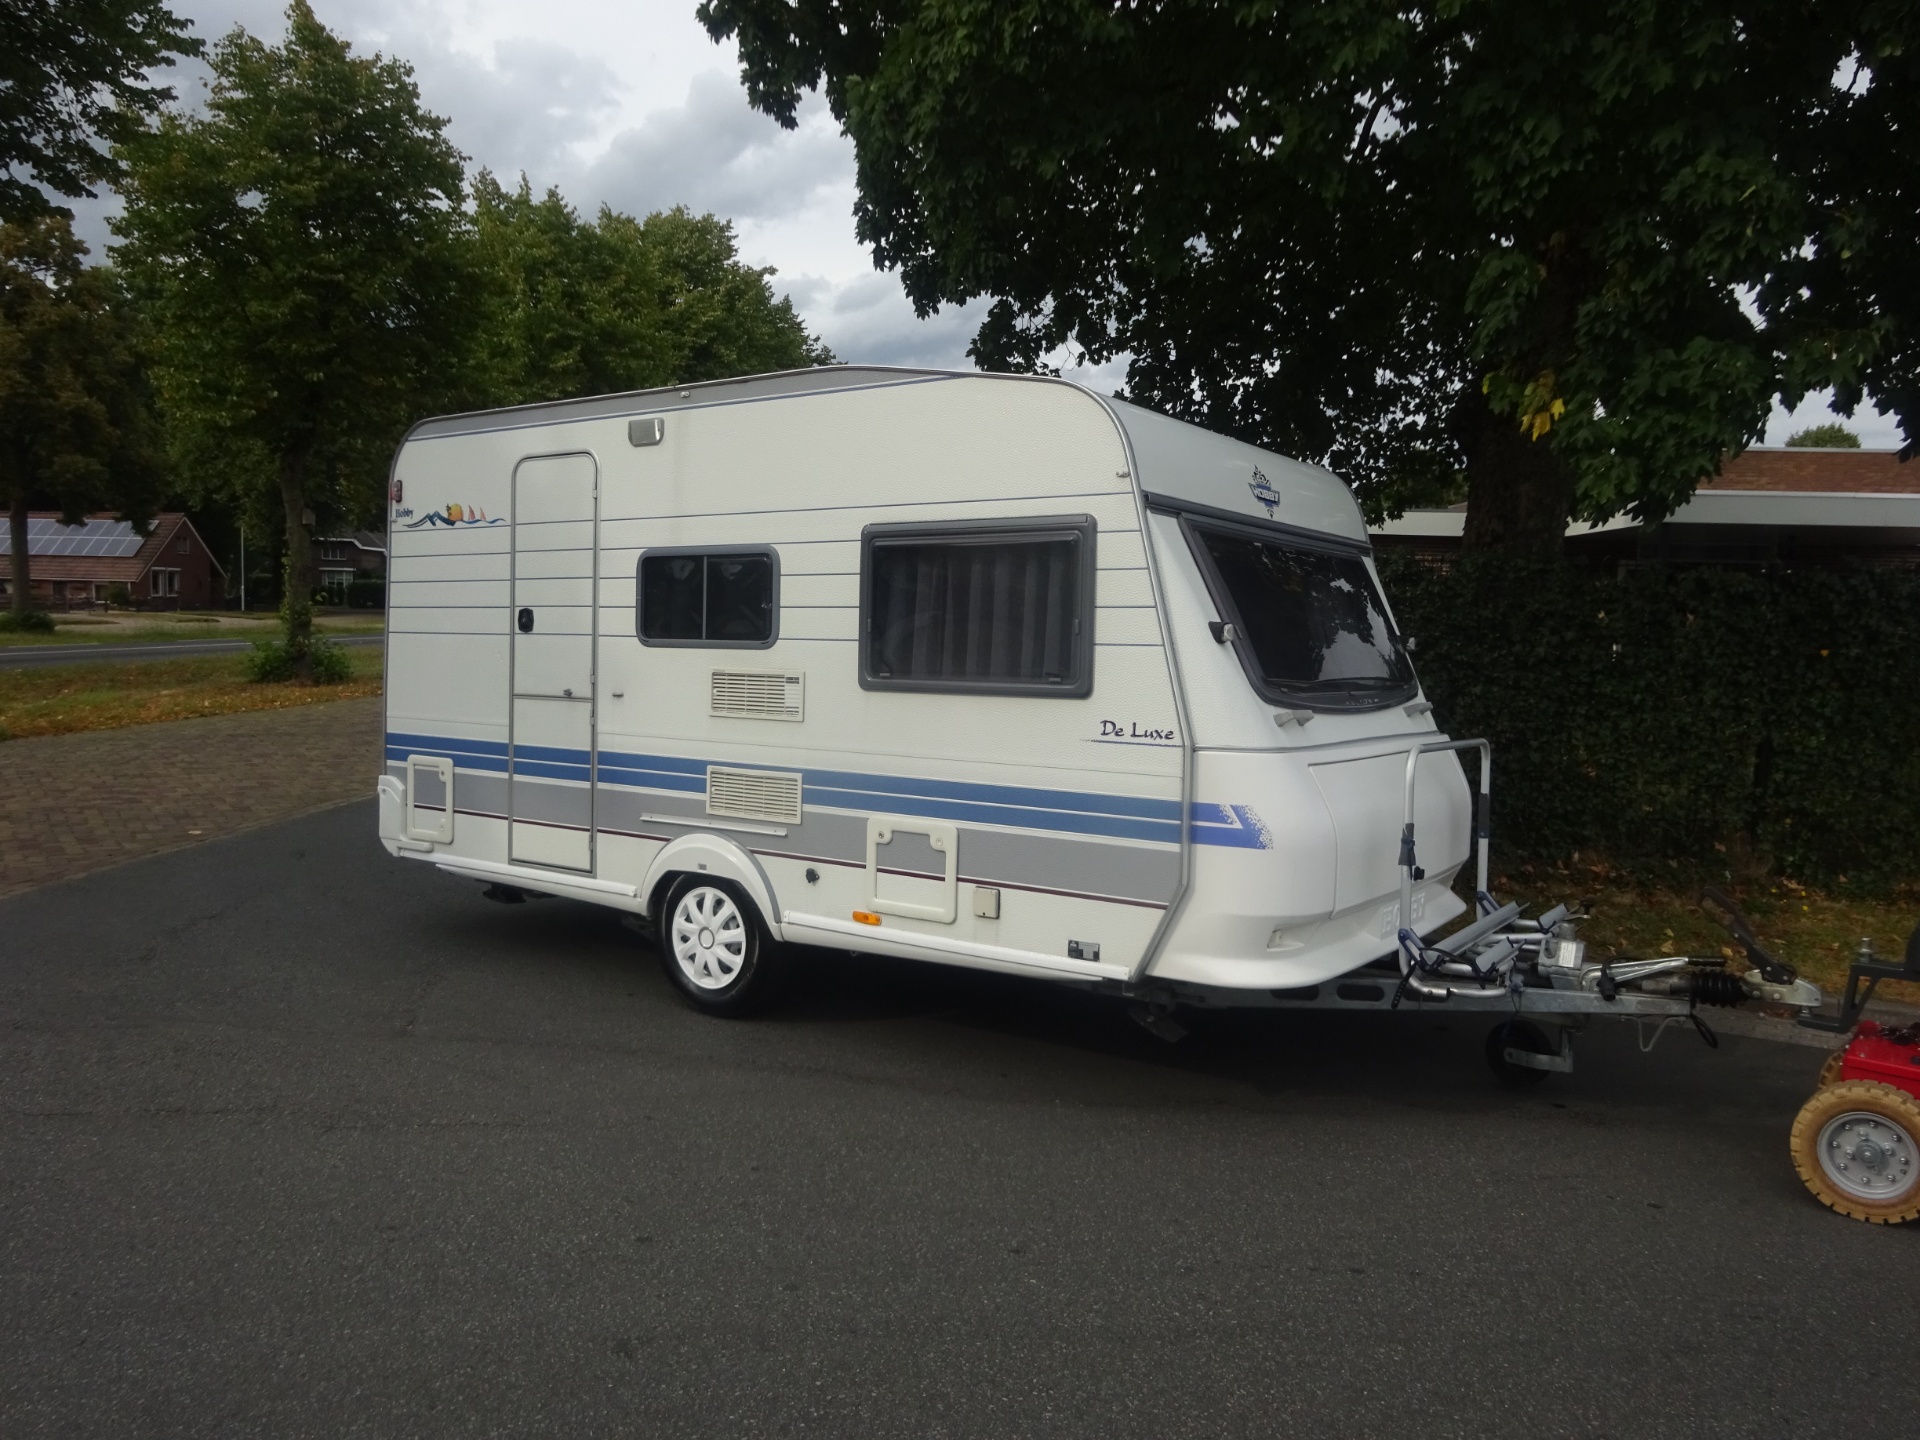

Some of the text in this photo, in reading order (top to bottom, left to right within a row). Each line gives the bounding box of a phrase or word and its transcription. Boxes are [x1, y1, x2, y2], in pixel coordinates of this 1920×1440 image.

[1249, 484, 1279, 503] HOBBY
[395, 507, 414, 519] Hobby
[1100, 720, 1175, 740] De Luxe
